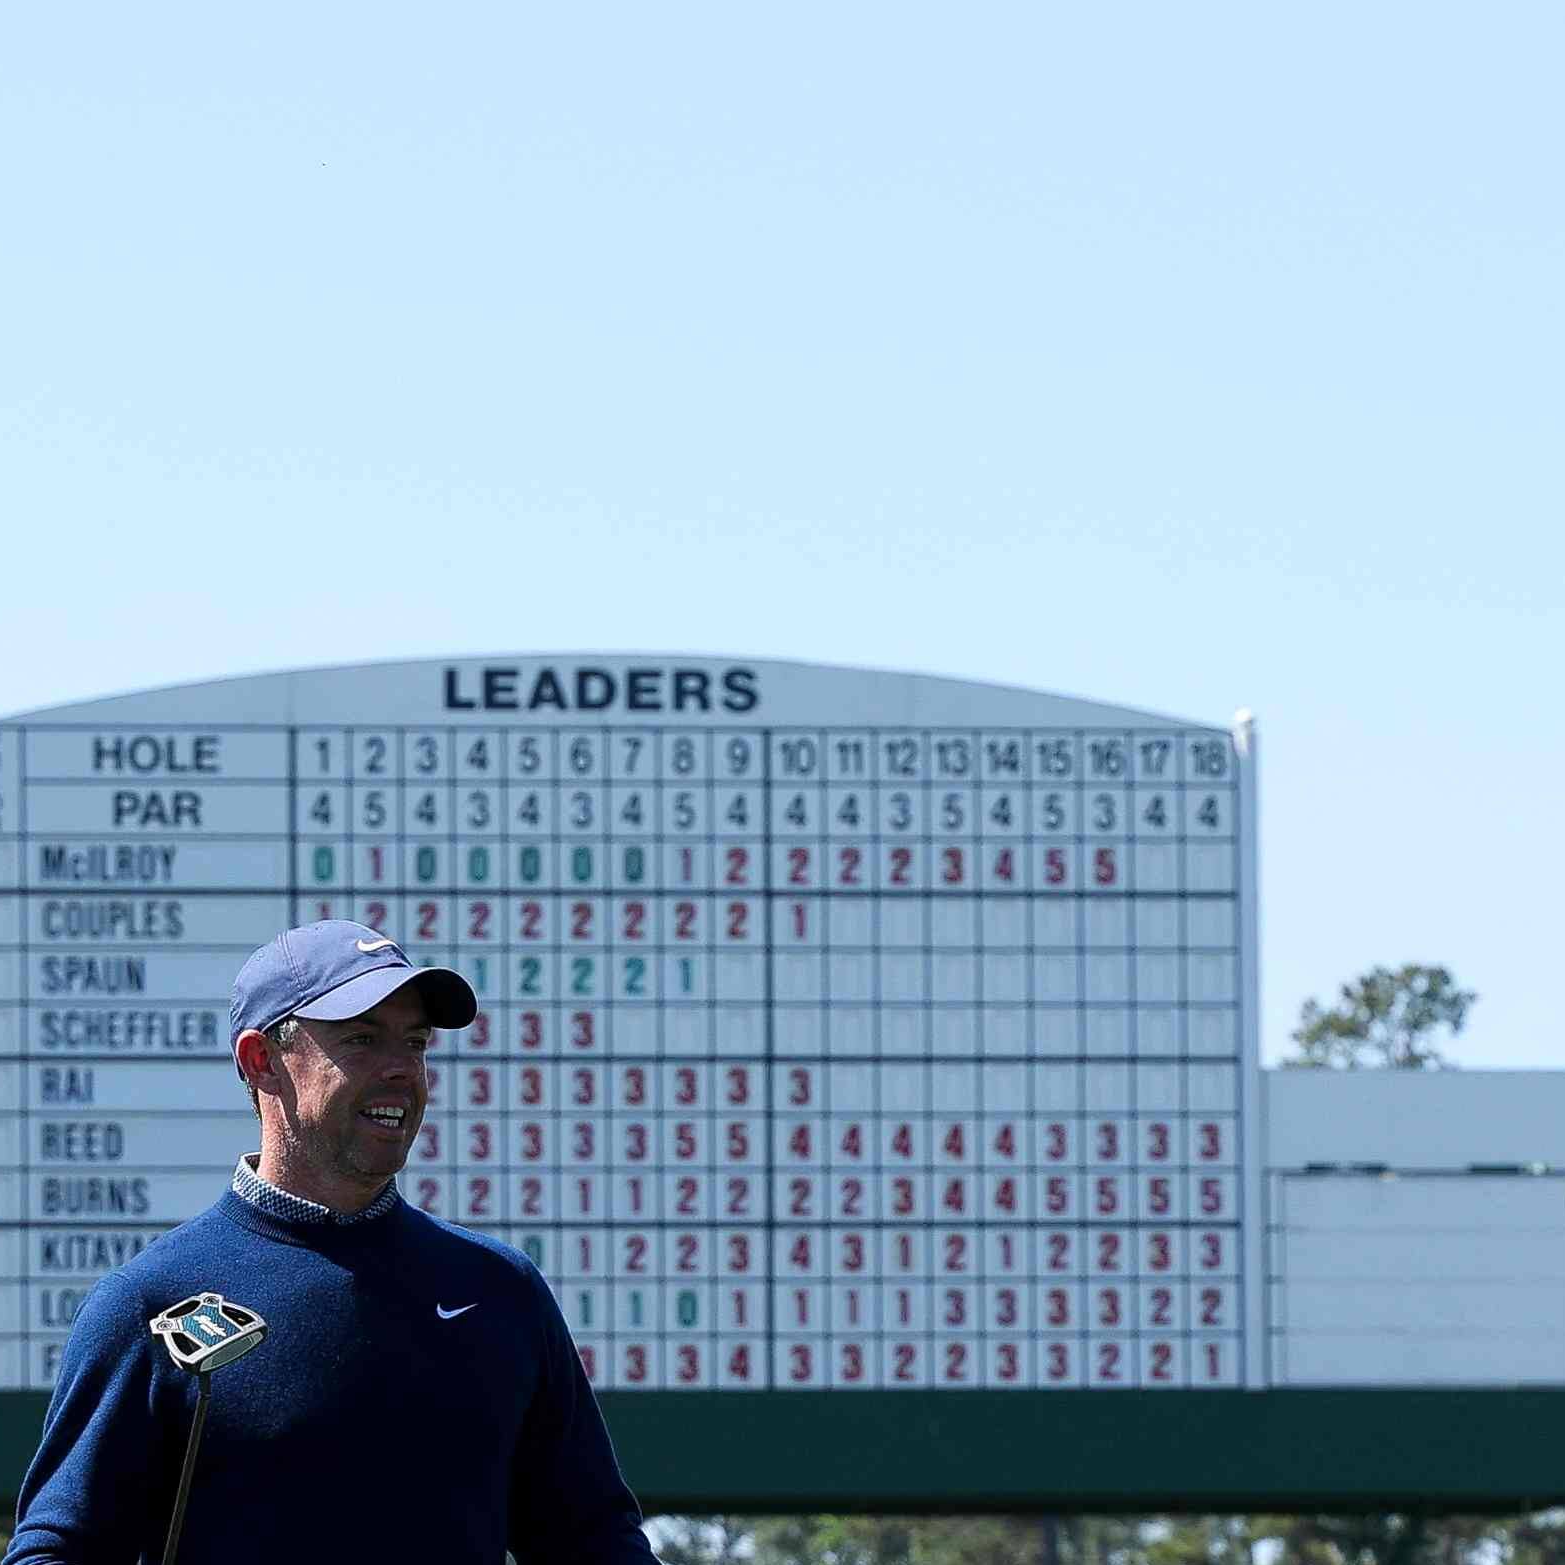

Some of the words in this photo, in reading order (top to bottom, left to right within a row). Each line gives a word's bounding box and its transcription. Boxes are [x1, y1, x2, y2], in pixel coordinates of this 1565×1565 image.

[444, 667, 759, 713] LEADERS
[93, 735, 219, 774] HOLE
[315, 737, 330, 772] 1
[365, 737, 386, 774] 2
[416, 736, 438, 774] 3
[467, 738, 489, 770] 4
[519, 736, 541, 775] 5
[570, 737, 593, 775] 6
[620, 736, 643, 774] 7
[674, 736, 697, 775] 8
[727, 736, 750, 776] 9
[781, 739, 816, 776] 10
[836, 741, 863, 772] 11
[885, 739, 917, 776] 12
[936, 739, 970, 776] 13
[987, 742, 1019, 772] 14
[1036, 740, 1071, 776] 15
[1086, 738, 1126, 776] 16
[1140, 736, 1178, 774] 17
[1192, 737, 1230, 776] 18
[113, 791, 201, 826] PAR
[311, 792, 331, 825] 4
[364, 792, 386, 829] 5
[415, 793, 437, 825] 4
[468, 792, 490, 829] 3
[519, 793, 540, 826] 4
[571, 792, 594, 830] 3
[621, 793, 643, 826] 4
[674, 792, 696, 830] 5
[727, 794, 748, 826] 4
[785, 794, 807, 826] 4
[838, 794, 860, 827] 4
[890, 792, 912, 830] 3
[942, 793, 964, 830] 5
[991, 794, 1012, 826] 4
[1043, 793, 1065, 830] 5
[1094, 793, 1116, 830] 3
[1144, 796, 1166, 827] 4
[1197, 796, 1219, 828] 4
[313, 846, 334, 884] 0
[368, 846, 383, 883] 1
[416, 846, 437, 884] 0
[468, 846, 489, 884] 0
[520, 846, 541, 884] 0
[572, 846, 593, 884] 0
[624, 846, 645, 884] 0
[678, 846, 694, 884] 1
[726, 847, 749, 885] 2
[788, 847, 810, 885] 2
[840, 847, 861, 885] 2
[890, 847, 912, 885] 2
[942, 847, 964, 885] 3
[994, 848, 1014, 883] 4
[1045, 848, 1066, 885] 5
[1094, 848, 1116, 885] 5
[41, 900, 183, 938] COUPLES
[416, 901, 438, 940] 2
[467, 901, 490, 940] 2
[520, 901, 542, 940] 2
[571, 901, 594, 940] 2
[622, 901, 645, 940] 2
[674, 901, 697, 939] 2
[725, 901, 748, 940] 2
[791, 901, 806, 939] 1
[40, 956, 146, 994] SPAUN
[520, 956, 541, 995] 2
[571, 956, 595, 995] 2
[624, 956, 646, 995] 2
[678, 956, 694, 993] 1
[40, 1010, 218, 1049] SCHEFFLER
[521, 1011, 542, 1049] 3
[572, 1011, 594, 1049] 3
[40, 1067, 94, 1102] RAI
[467, 1067, 491, 1106] 3
[521, 1067, 542, 1106] 3
[572, 1067, 595, 1106] 3
[621, 1067, 647, 1106] 3
[675, 1067, 699, 1105] 3
[727, 1067, 751, 1105] 3
[788, 1067, 811, 1106] 3
[40, 1122, 124, 1161] REED
[470, 1122, 491, 1161] 3
[522, 1122, 543, 1161] 3
[574, 1122, 594, 1161] 3
[625, 1123, 647, 1161] 3
[675, 1122, 696, 1160] 5
[727, 1122, 749, 1161] 5
[789, 1123, 811, 1159] 4
[841, 1124, 862, 1158] 4
[892, 1123, 913, 1159] 4
[944, 1123, 965, 1160] 4
[994, 1124, 1015, 1159] 4
[1046, 1123, 1067, 1161] 3
[1098, 1122, 1119, 1161] 3
[1148, 1123, 1169, 1161] 3
[1200, 1123, 1221, 1161] 3
[40, 1177, 150, 1215] BURNS
[468, 1177, 491, 1216] 2
[521, 1177, 542, 1215] 2
[577, 1178, 592, 1214] 1
[627, 1177, 643, 1214] 1
[676, 1177, 698, 1215] 2
[727, 1177, 749, 1215] 2
[789, 1178, 811, 1216] 2
[841, 1178, 862, 1216] 2
[893, 1177, 914, 1216] 3
[943, 1178, 965, 1213] 4
[995, 1178, 1015, 1214] 4
[1046, 1177, 1067, 1215] 5
[1097, 1177, 1117, 1215] 5
[1149, 1178, 1170, 1215] 5
[1200, 1177, 1222, 1216] 5
[574, 1233, 589, 1272] 1
[621, 1233, 646, 1273] 2
[675, 1233, 699, 1272] 2
[728, 1233, 749, 1272] 3
[790, 1233, 811, 1270] 4
[843, 1233, 864, 1272] 3
[897, 1233, 913, 1272] 1
[944, 1233, 966, 1272] 2
[998, 1233, 1014, 1269] 1
[1048, 1233, 1070, 1271] 2
[1098, 1233, 1120, 1271] 2
[1149, 1233, 1171, 1271] 3
[1201, 1233, 1221, 1270] 3
[574, 1291, 589, 1328] 1
[628, 1290, 643, 1327] 1
[677, 1289, 698, 1328] 0
[732, 1290, 747, 1327] 1
[793, 1288, 809, 1326] 1
[845, 1289, 861, 1328] 1
[896, 1289, 910, 1326] 1
[944, 1288, 966, 1327] 3
[996, 1288, 1017, 1327] 3
[1048, 1289, 1069, 1327] 3
[1100, 1288, 1121, 1326] 3
[1150, 1288, 1172, 1326] 2
[1201, 1288, 1222, 1326] 2
